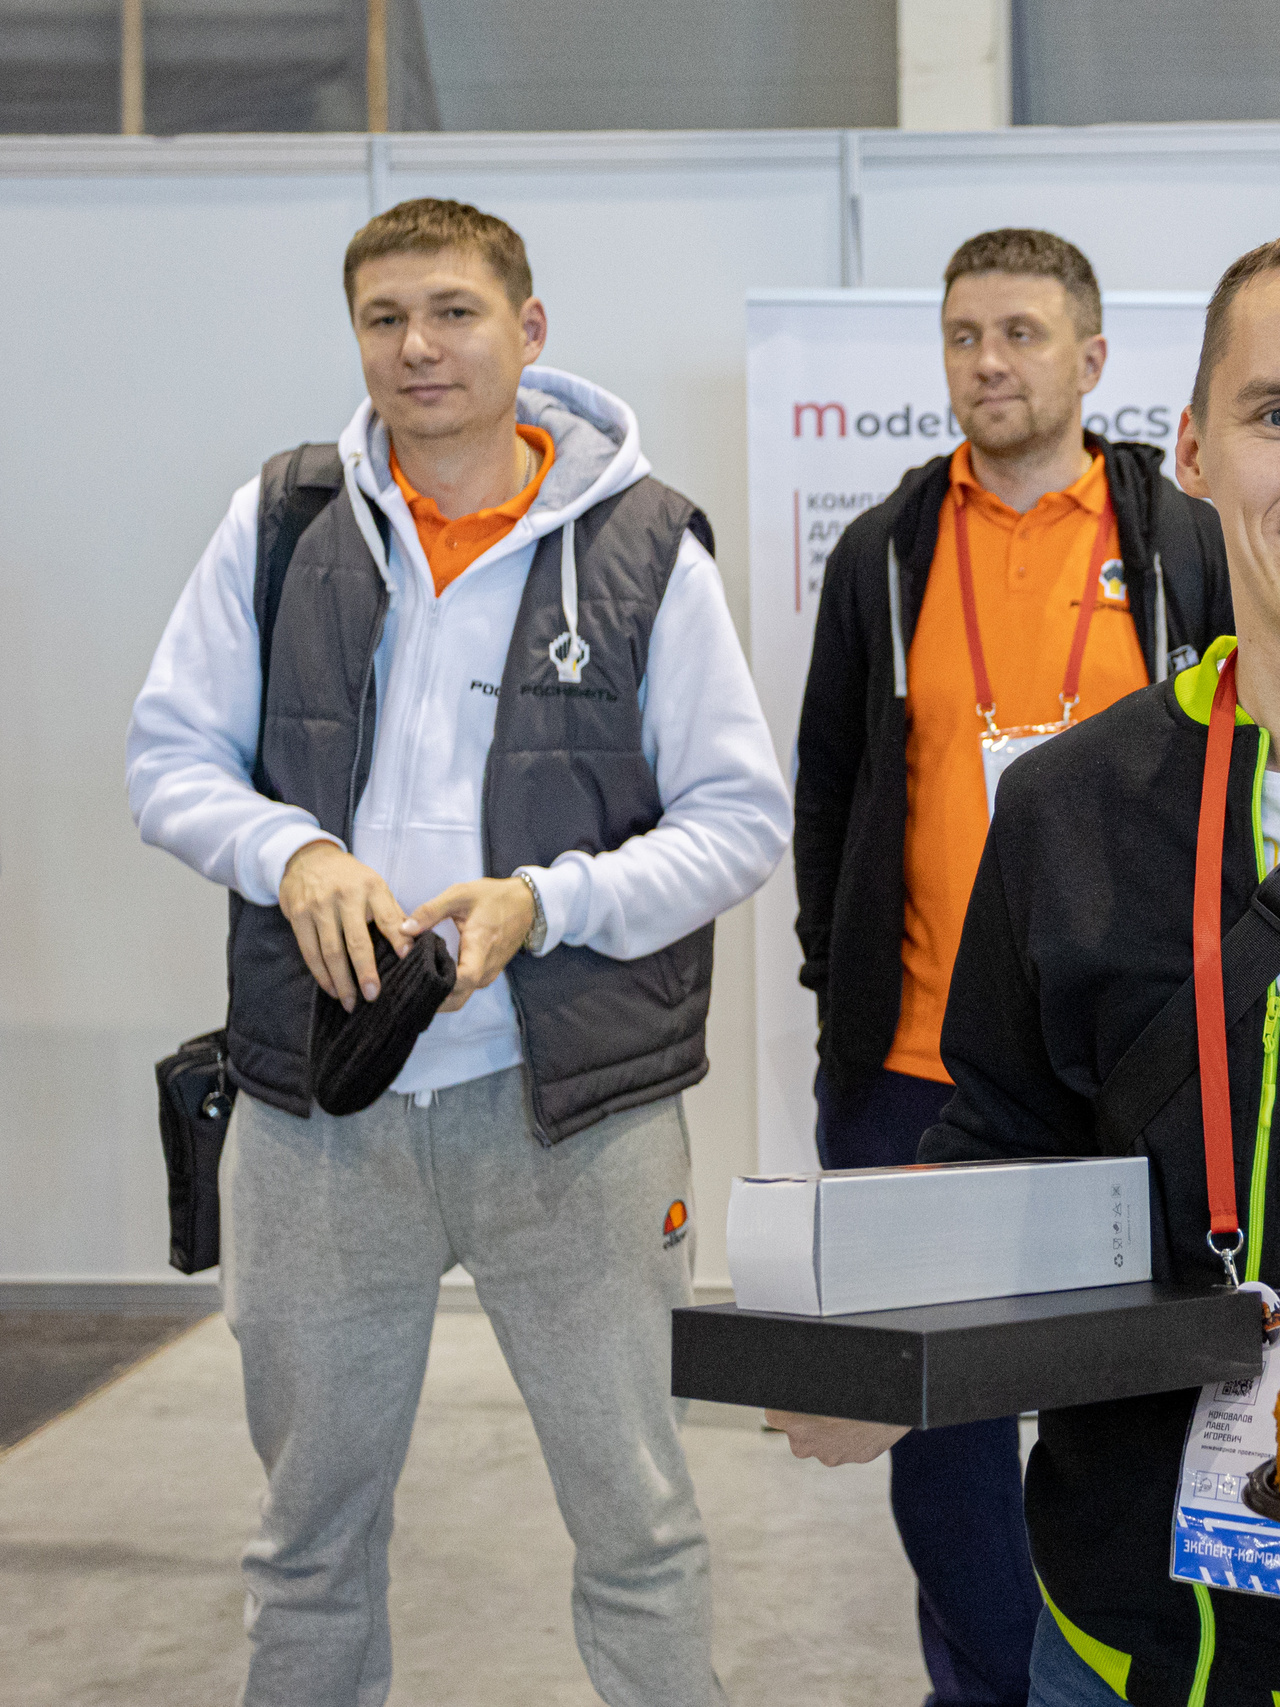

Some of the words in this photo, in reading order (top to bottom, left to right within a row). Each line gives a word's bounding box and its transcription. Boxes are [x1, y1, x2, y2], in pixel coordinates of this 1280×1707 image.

[1208, 1410, 1253, 1424] КОНОВАЛОВ
[1205, 1421, 1230, 1431] ПАВЕЛ
[1203, 1431, 1242, 1443] ИГОРЕВИЧ
